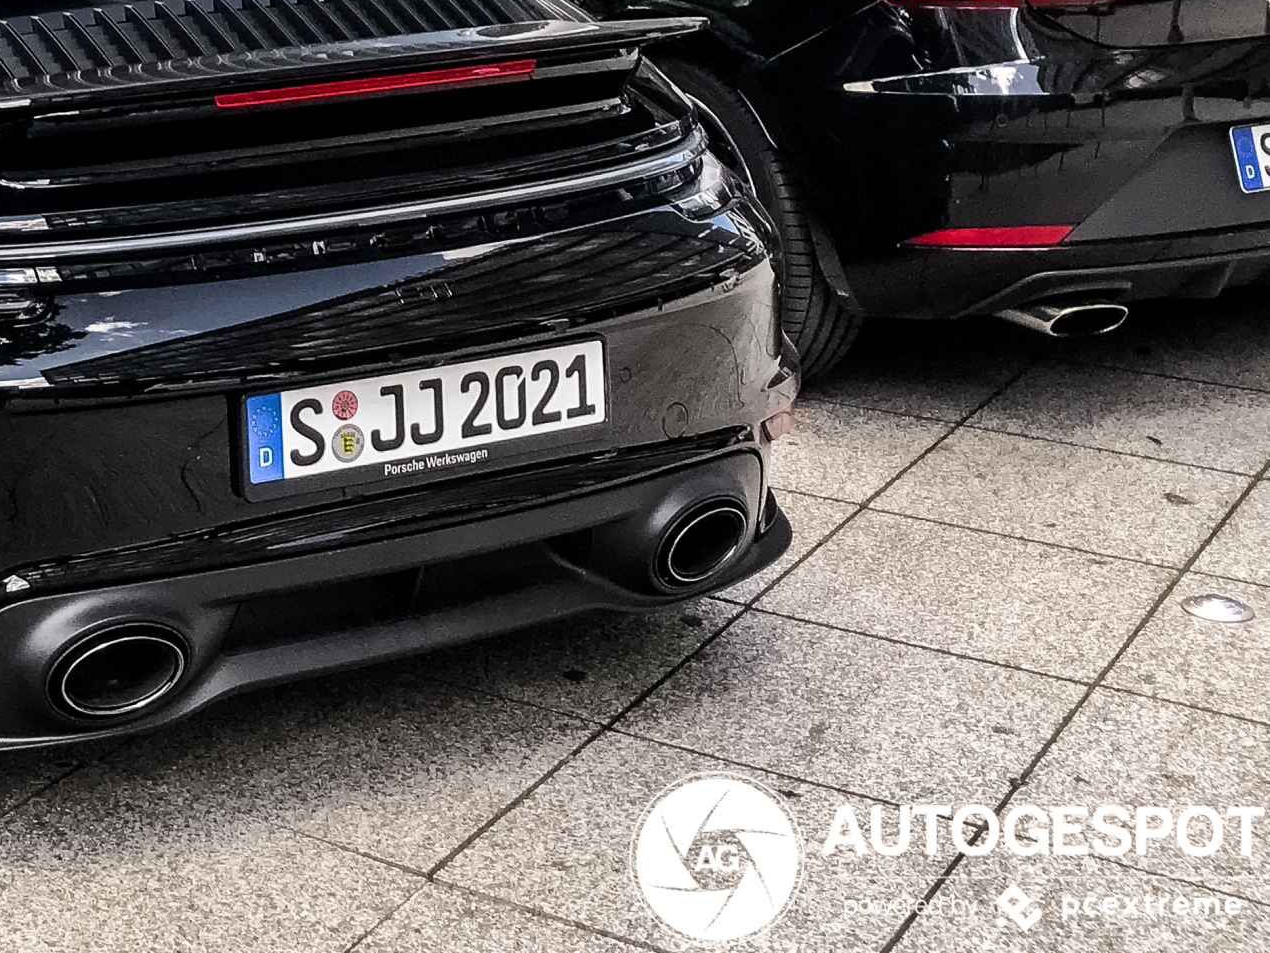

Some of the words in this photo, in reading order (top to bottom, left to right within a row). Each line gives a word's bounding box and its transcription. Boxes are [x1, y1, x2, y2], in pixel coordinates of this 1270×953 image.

[1245, 165, 1255, 179] D
[290, 398, 326, 466] S
[371, 378, 444, 452] JJ
[460, 354, 596, 439] 2021
[259, 447, 273, 467] D
[384, 457, 424, 476] Porsche
[426, 449, 488, 469] Werkswagen
